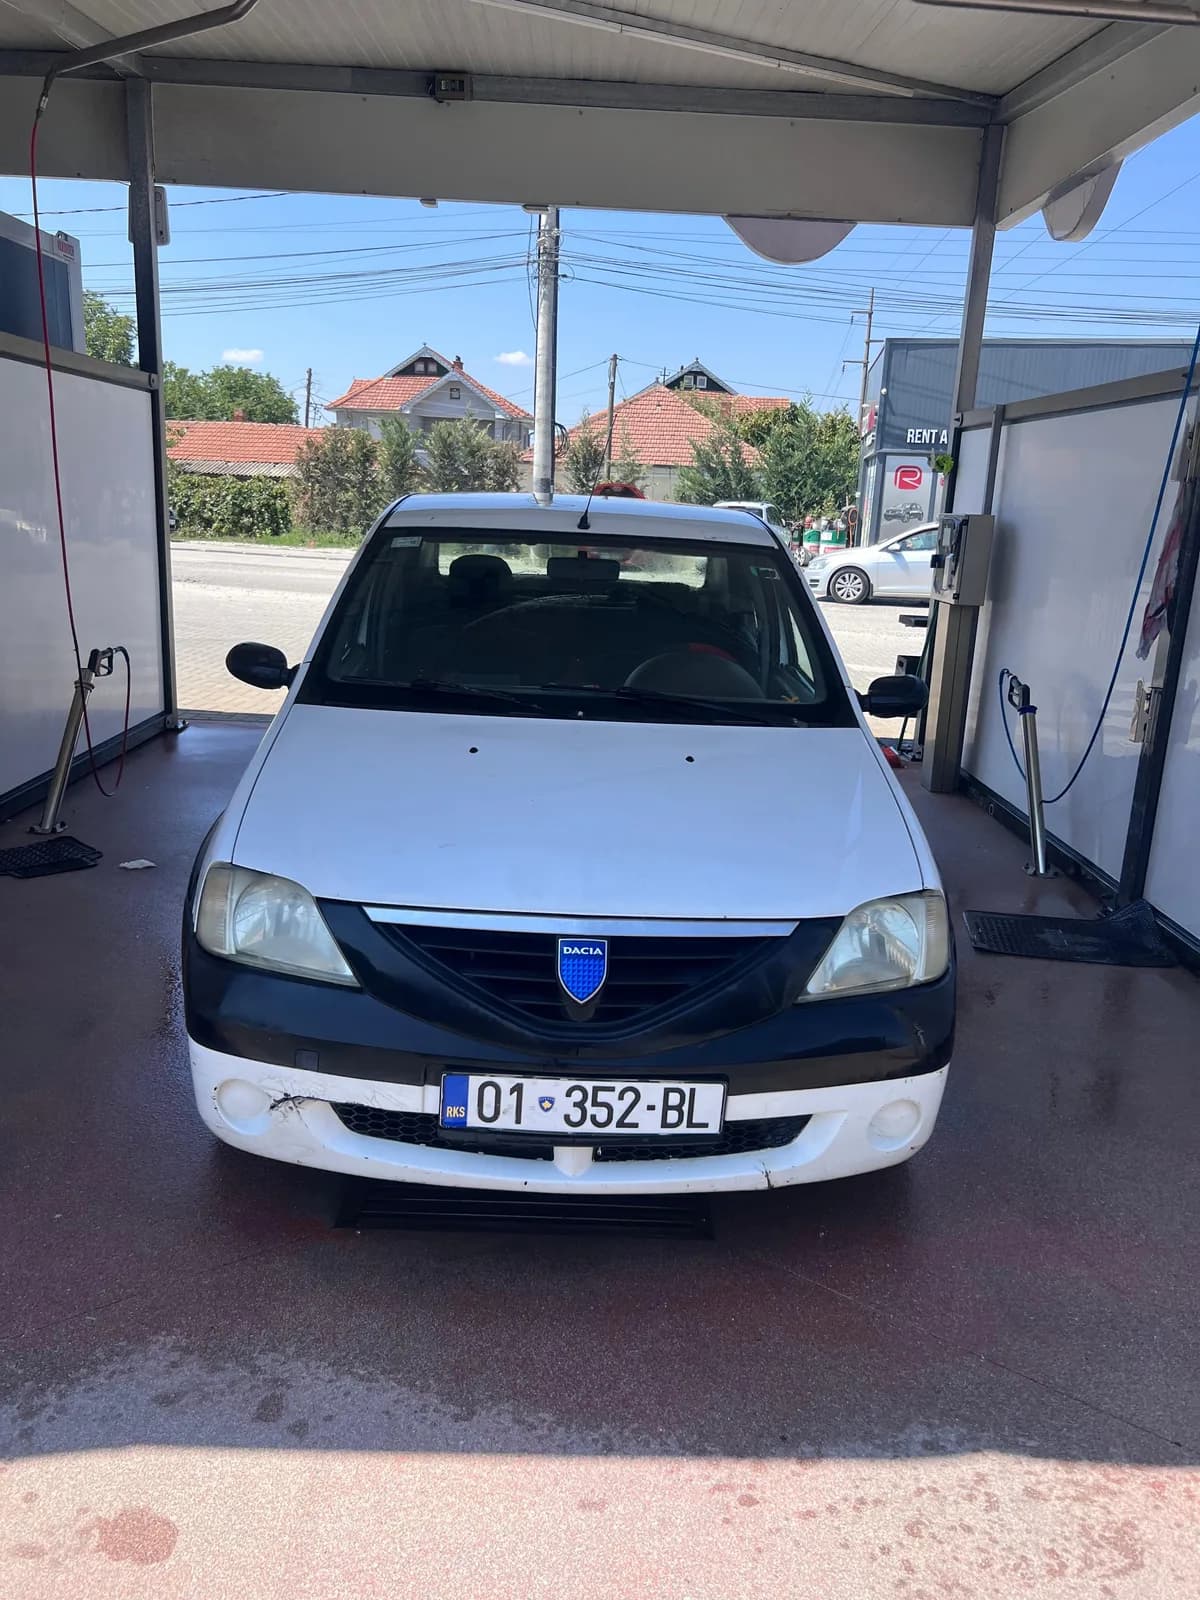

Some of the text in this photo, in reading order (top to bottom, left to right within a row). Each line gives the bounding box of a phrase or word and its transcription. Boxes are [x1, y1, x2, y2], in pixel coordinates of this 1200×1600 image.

[906, 428, 948, 444] RENT A
[895, 466, 922, 490] R
[563, 946, 603, 955] DACIA
[446, 1105, 466, 1118] RKS
[477, 1080, 709, 1129] 01 352-BL
